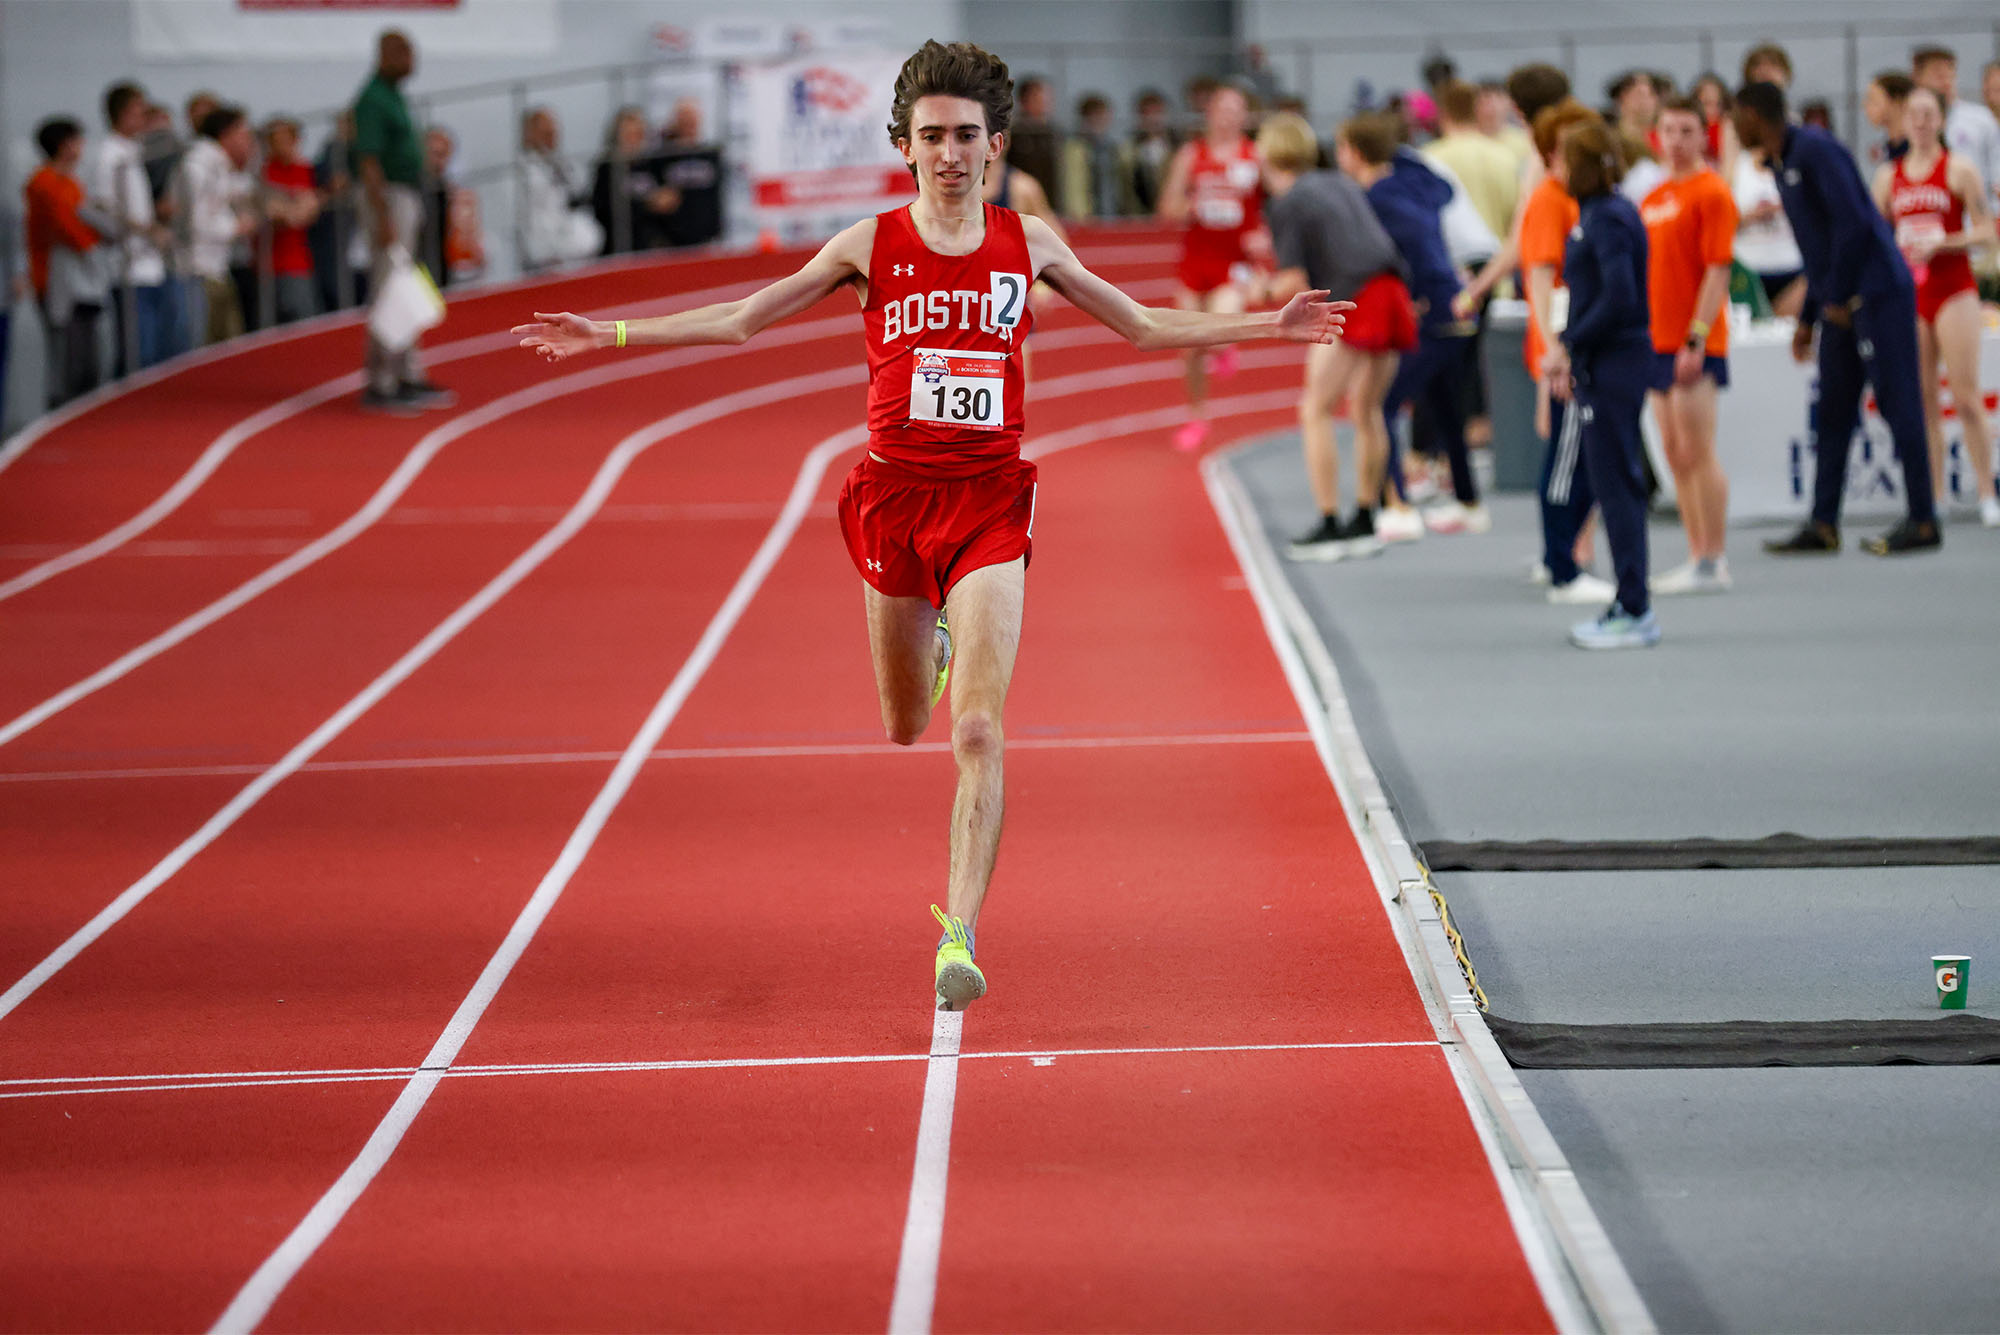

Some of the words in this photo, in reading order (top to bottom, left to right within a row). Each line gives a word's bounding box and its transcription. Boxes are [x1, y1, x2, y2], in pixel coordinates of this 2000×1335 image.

[883, 290, 1008, 344] BOSTO
[998, 276, 1019, 325] 2
[931, 385, 992, 421] 130
[1936, 967, 1958, 993] G
